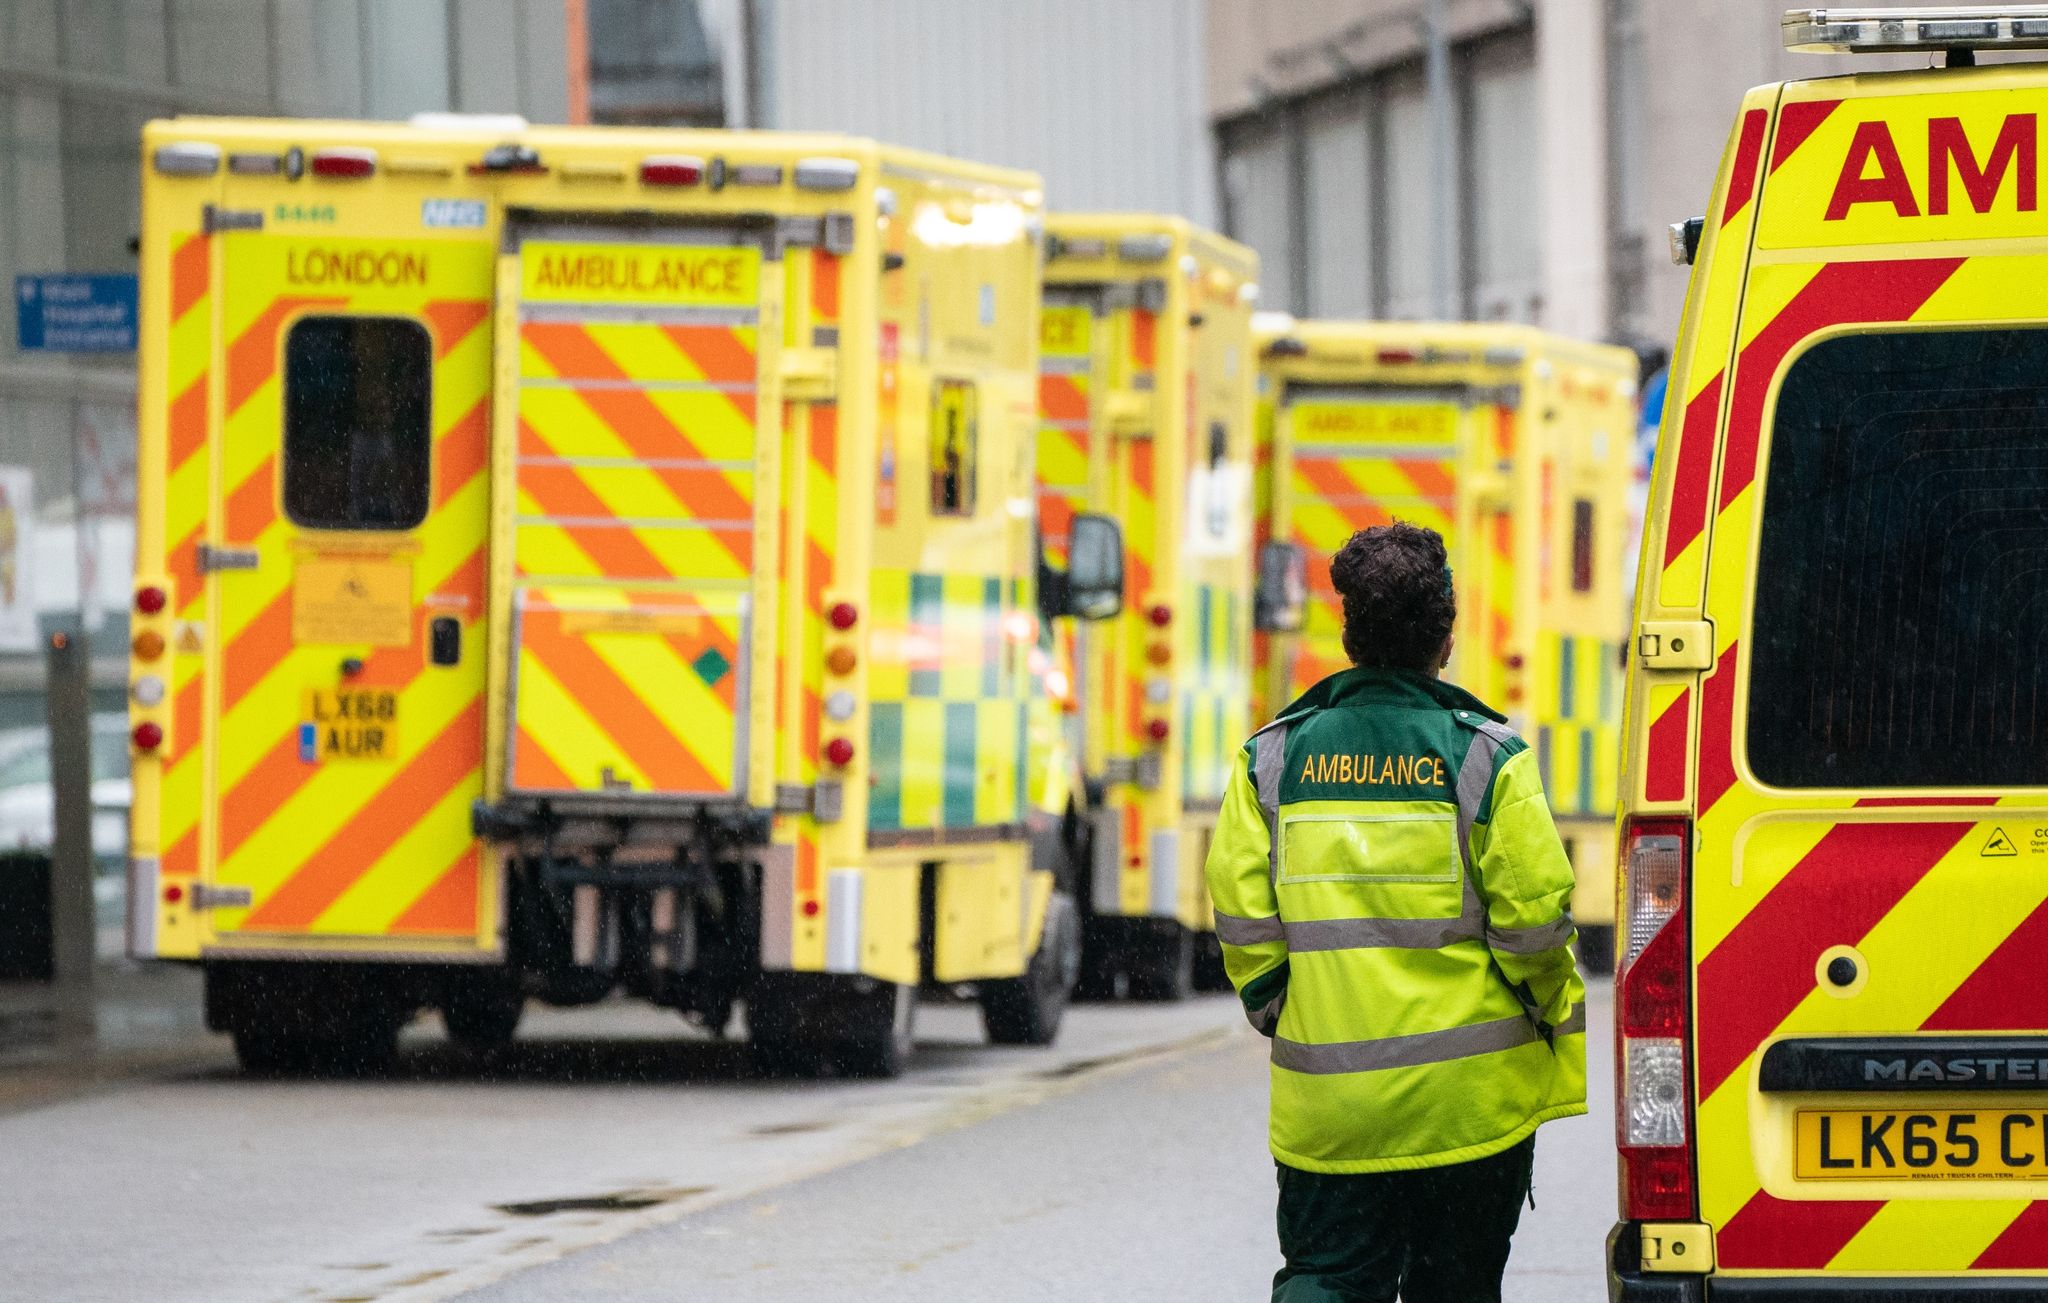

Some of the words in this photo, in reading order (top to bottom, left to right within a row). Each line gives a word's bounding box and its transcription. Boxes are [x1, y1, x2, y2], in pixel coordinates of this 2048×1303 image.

[1823, 113, 2037, 221] AM
[287, 248, 427, 286] LONDON
[536, 253, 743, 297] AMBULANCE
[1301, 754, 1445, 786] AMBULANCE
[1864, 1058, 2048, 1081] MASTE
[1820, 1114, 1979, 1168] LK65
[2000, 1114, 2048, 1167] C
